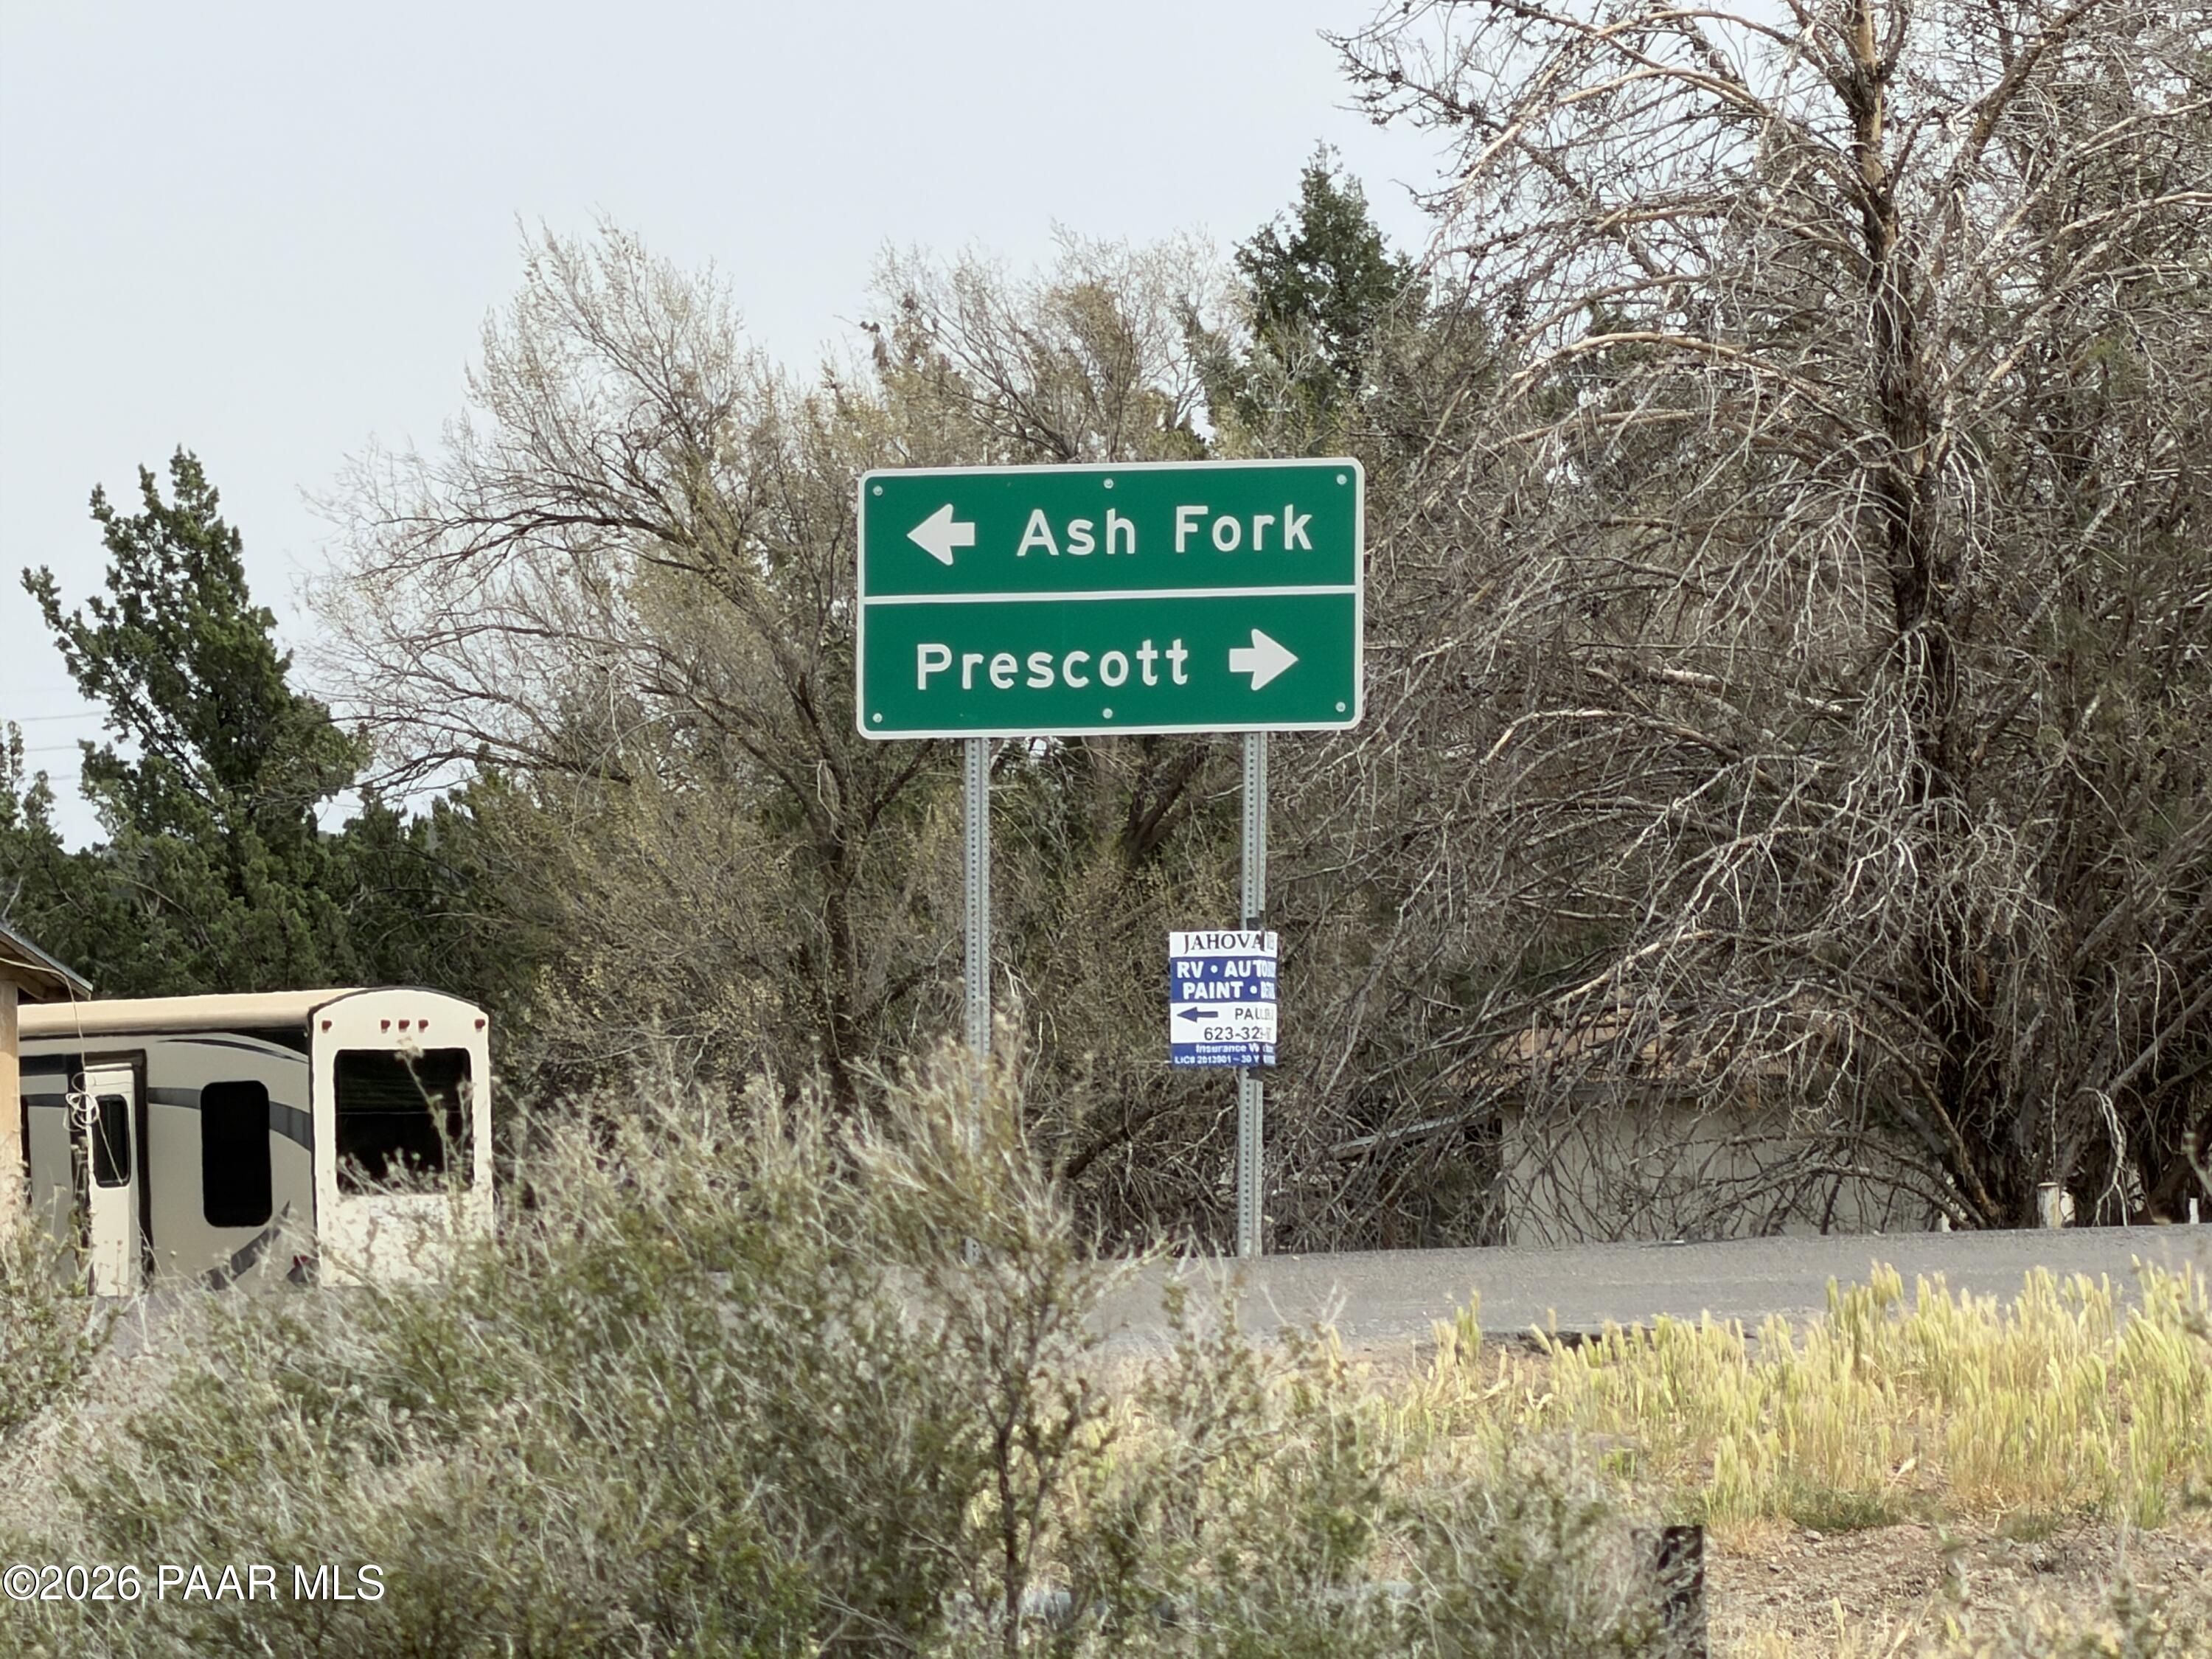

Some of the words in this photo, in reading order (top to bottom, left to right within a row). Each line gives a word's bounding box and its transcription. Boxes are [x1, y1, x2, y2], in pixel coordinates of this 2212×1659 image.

[1017, 507, 1136, 557] Ash
[1175, 504, 1313, 553] Fork
[917, 638, 1189, 691] Prescott
[1176, 960, 1204, 979] RV
[1182, 981, 1245, 1000] PAINT
[1195, 1043, 1247, 1054] Insurance
